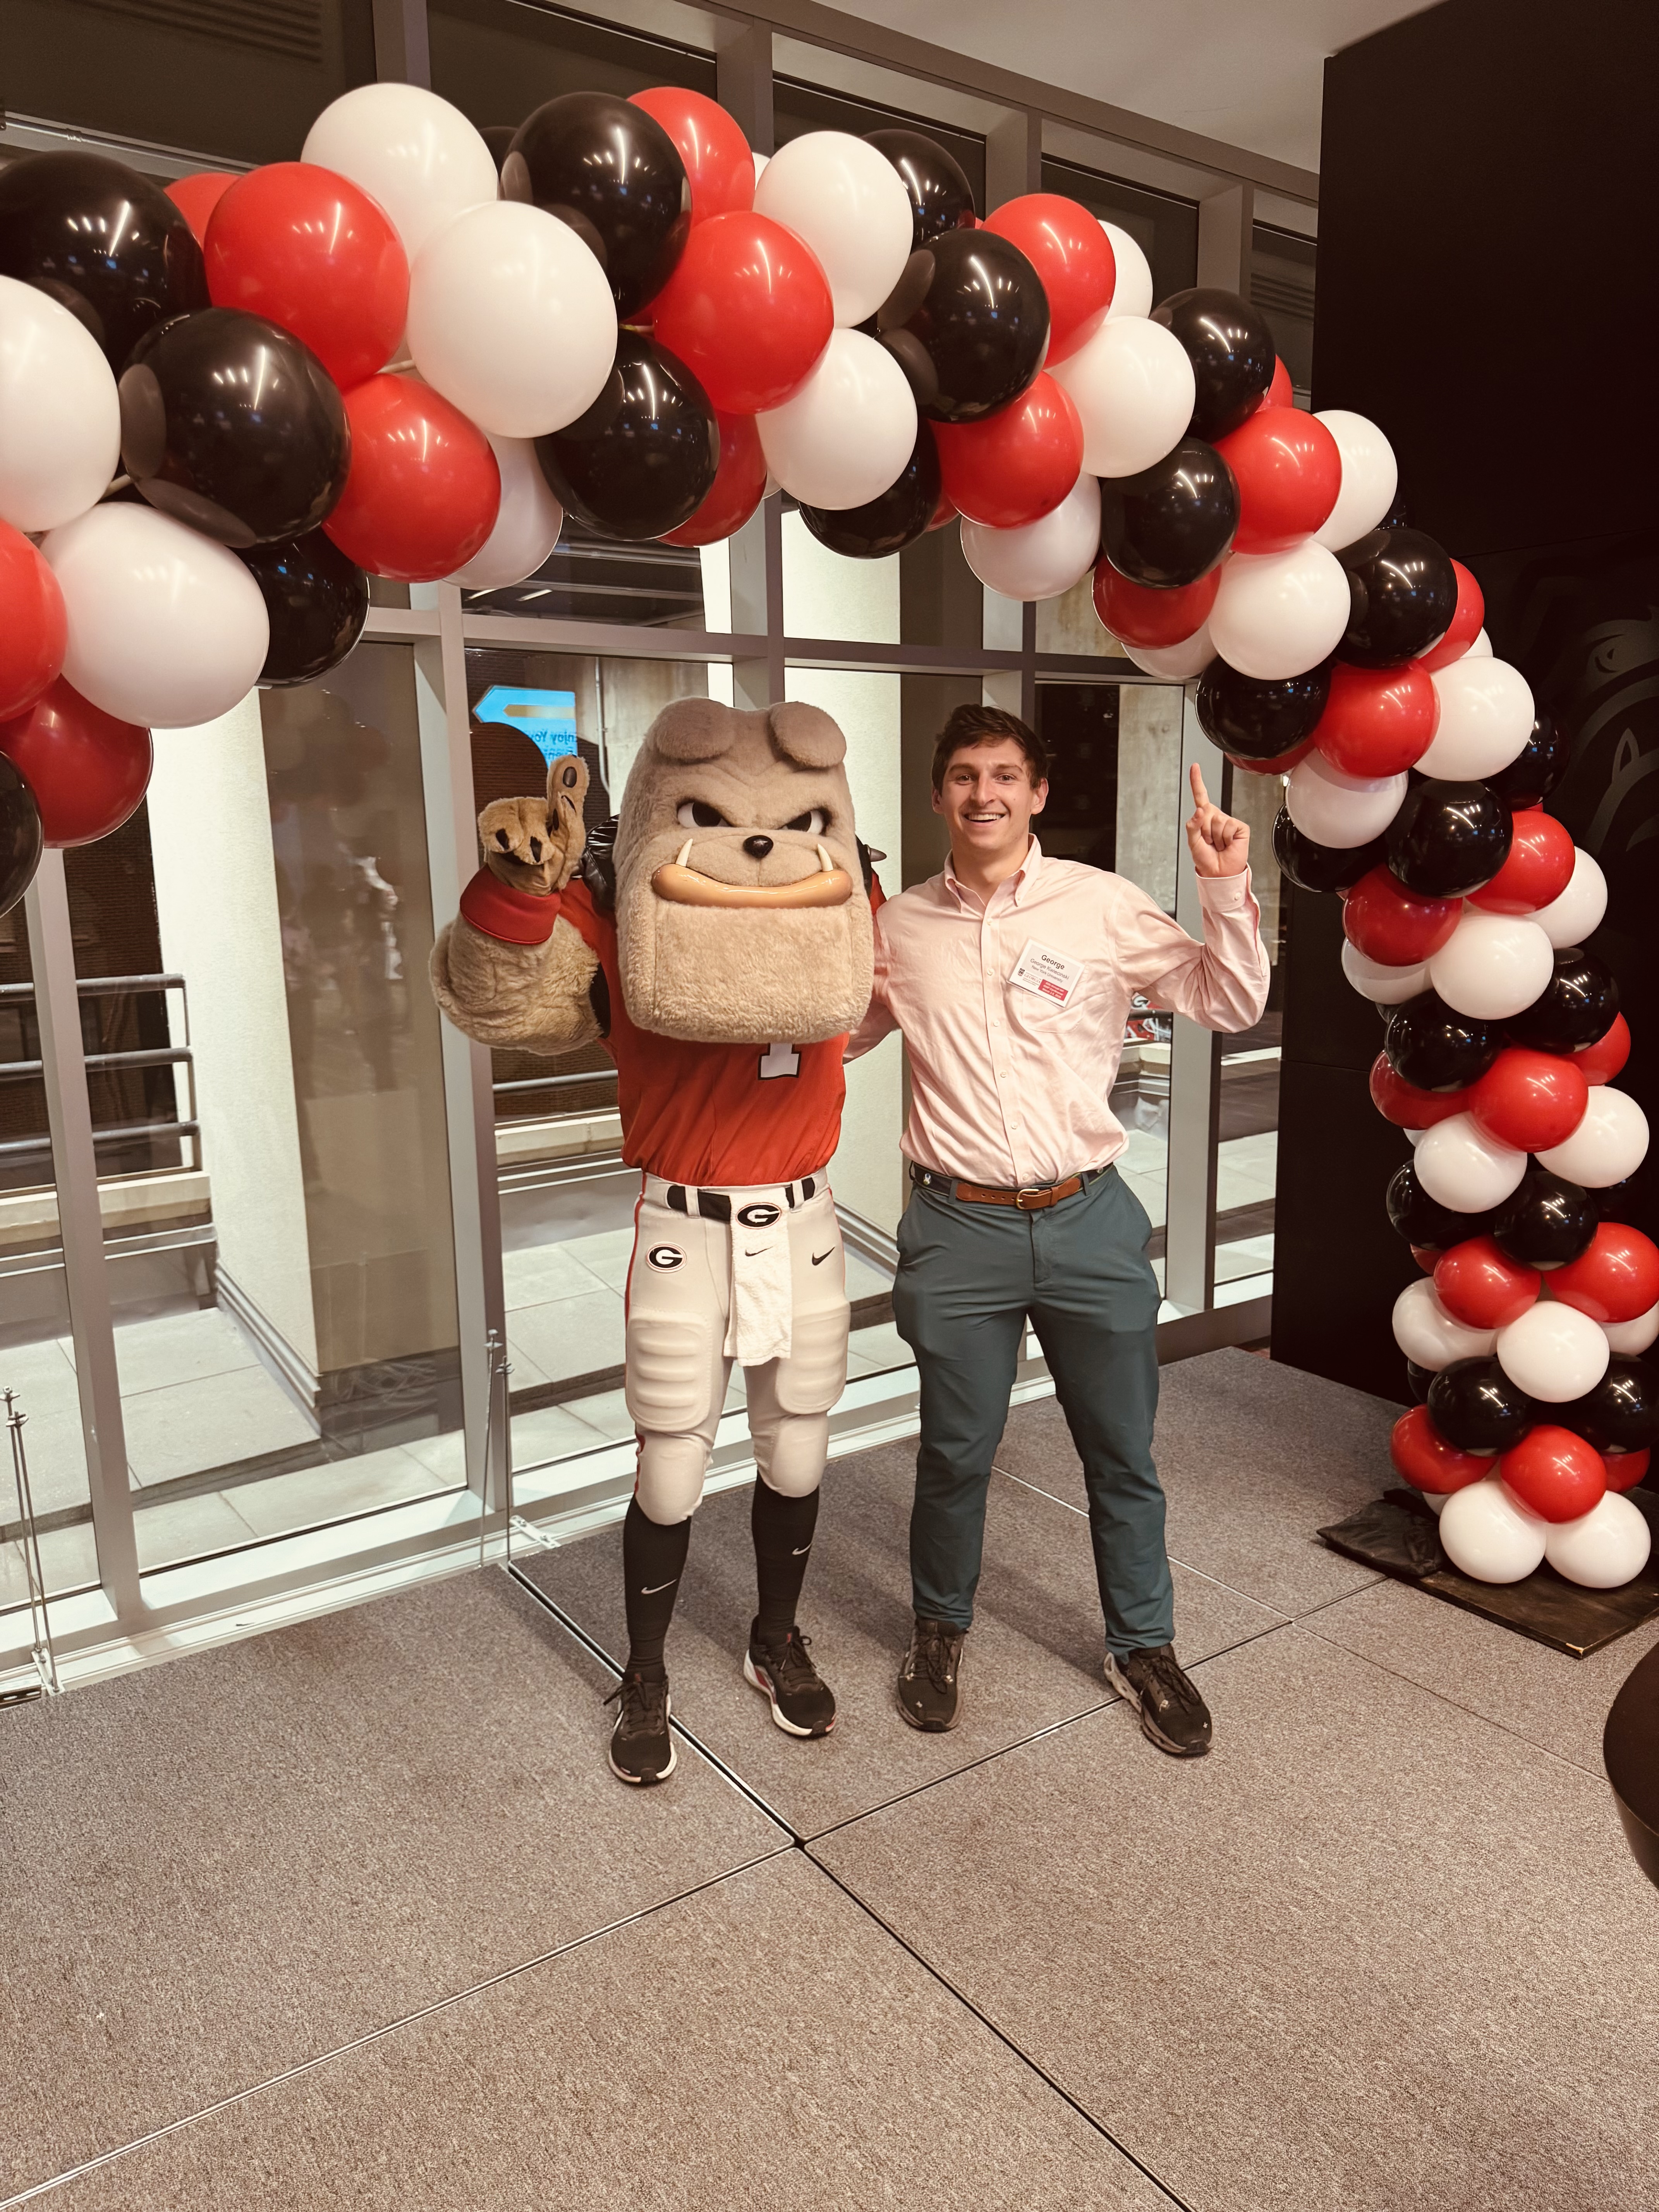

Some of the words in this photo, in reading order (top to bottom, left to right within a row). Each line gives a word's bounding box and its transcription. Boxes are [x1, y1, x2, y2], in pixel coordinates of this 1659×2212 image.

[1030, 958, 1046, 969] George
[1041, 955, 1065, 970] George
[1047, 972, 1063, 983] University
